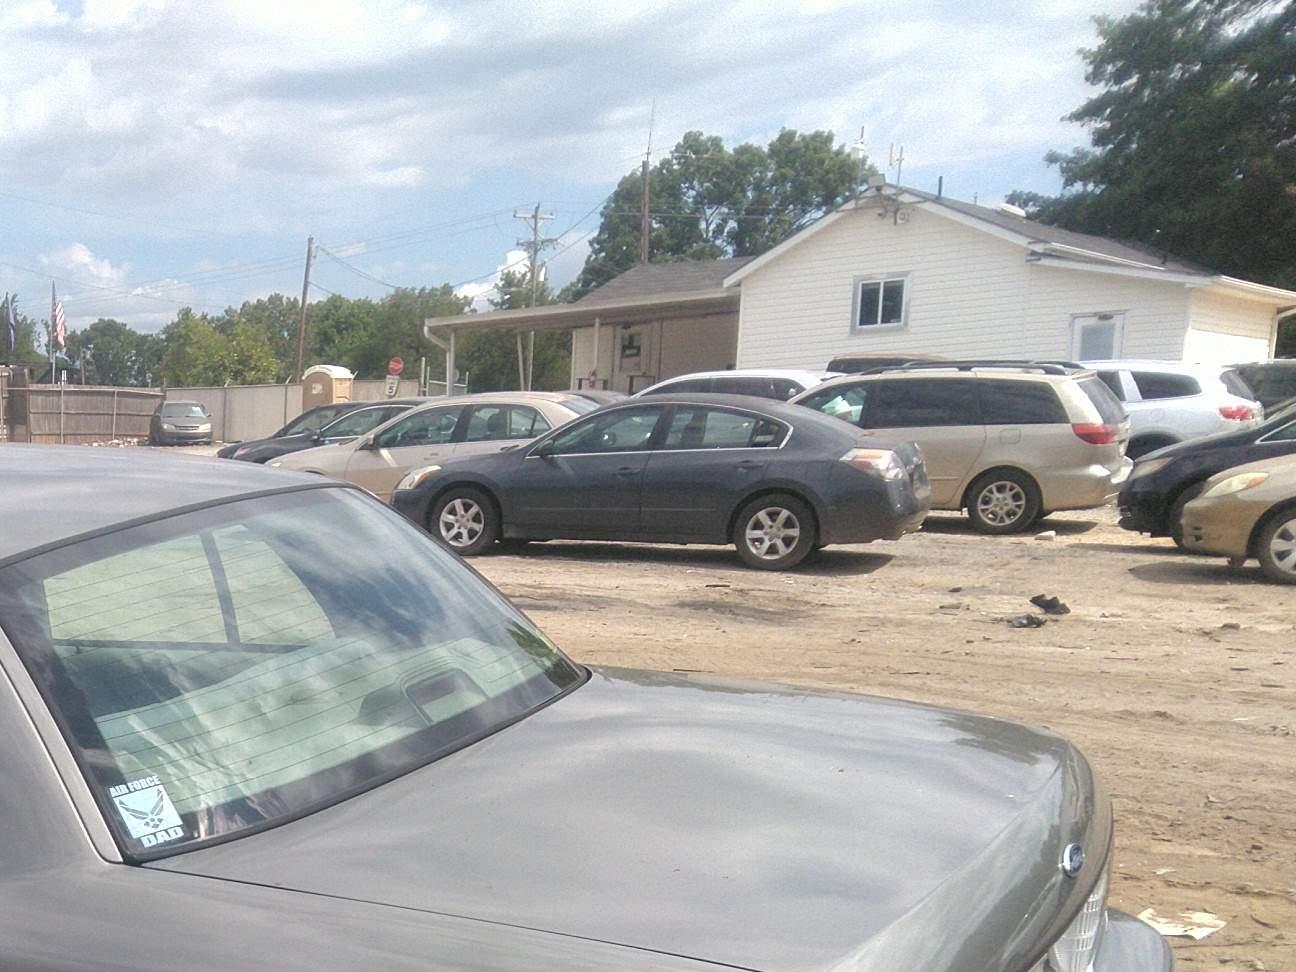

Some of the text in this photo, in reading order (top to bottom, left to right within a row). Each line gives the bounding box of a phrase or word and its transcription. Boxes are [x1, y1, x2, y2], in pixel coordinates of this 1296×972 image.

[109, 775, 161, 798] AIR FORCE
[140, 826, 184, 849] DAD
